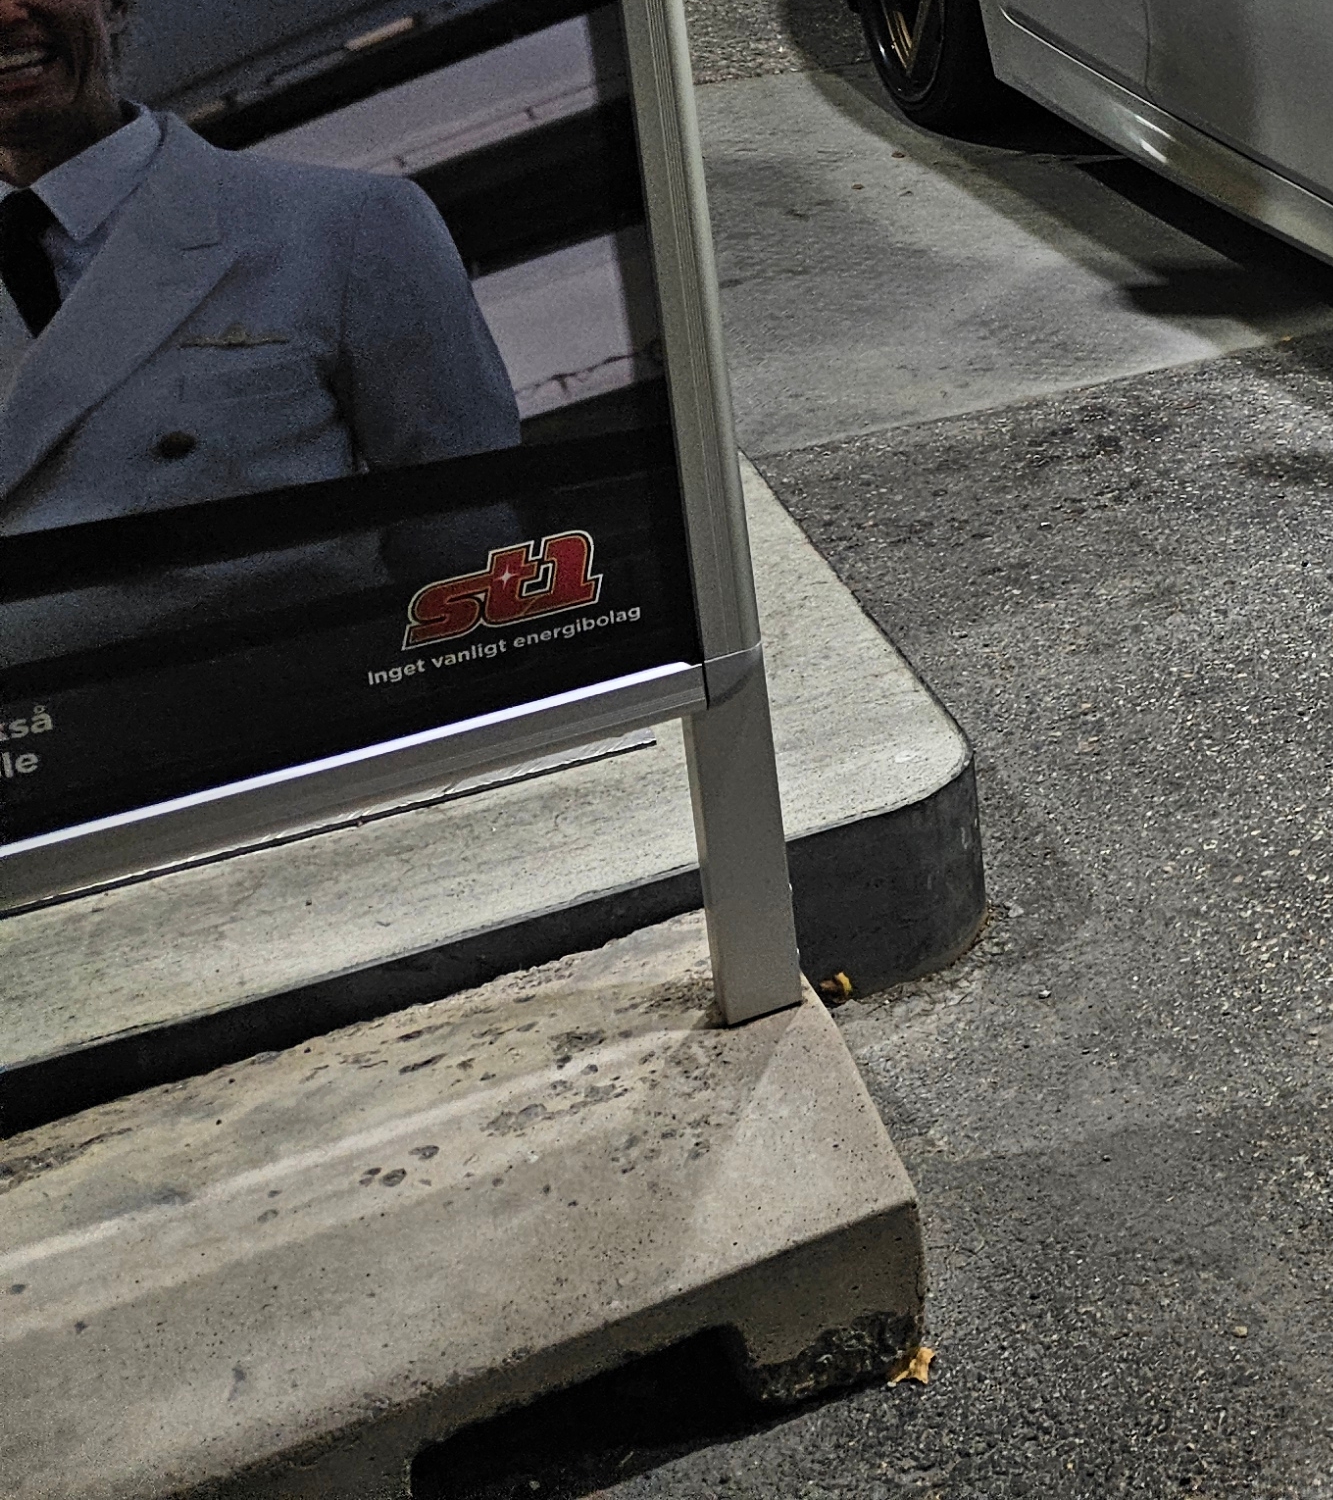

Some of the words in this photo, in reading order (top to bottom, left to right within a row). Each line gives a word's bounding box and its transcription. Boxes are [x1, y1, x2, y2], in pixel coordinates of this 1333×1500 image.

[402, 530, 603, 651] st1
[367, 659, 426, 686] Inget
[432, 638, 507, 669] vanligt
[513, 606, 641, 648] energibolag
